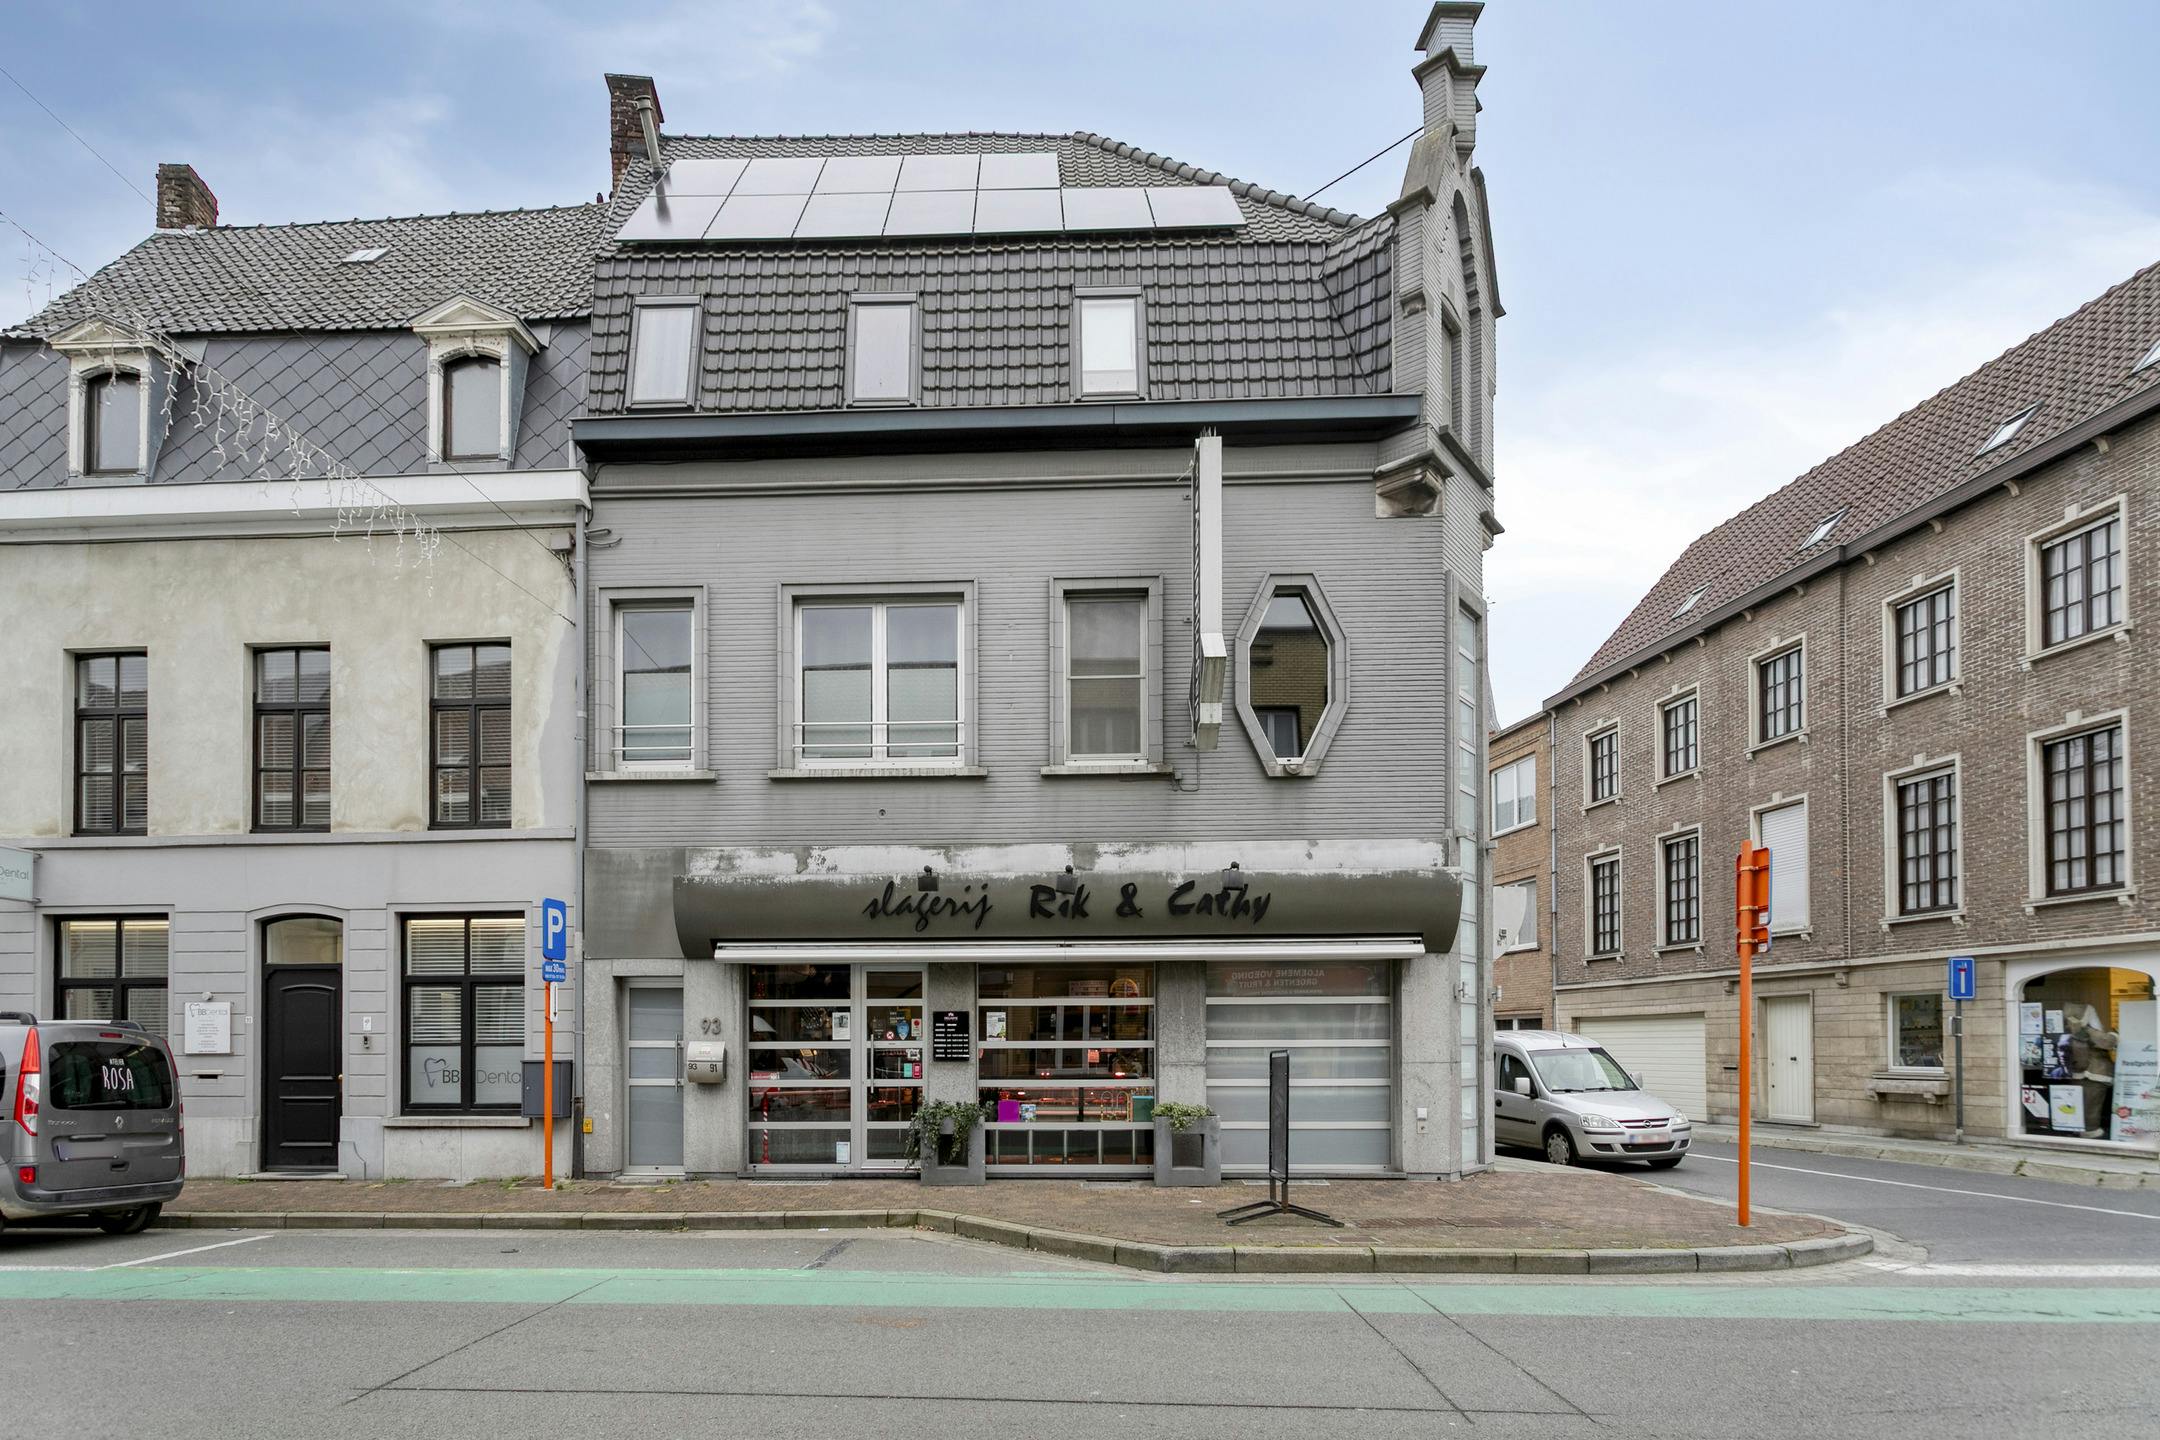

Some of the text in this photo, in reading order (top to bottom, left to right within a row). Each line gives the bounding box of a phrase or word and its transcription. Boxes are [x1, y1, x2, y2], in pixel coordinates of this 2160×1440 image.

[862, 880, 1271, 932] slagerij Rik & Cathy
[547, 907, 564, 950] P
[701, 1017, 721, 1035] 93
[688, 1062, 698, 1071] 93
[709, 1063, 718, 1073] 91
[102, 1065, 134, 1091] ROSA
[442, 1069, 521, 1085] BB Denta
